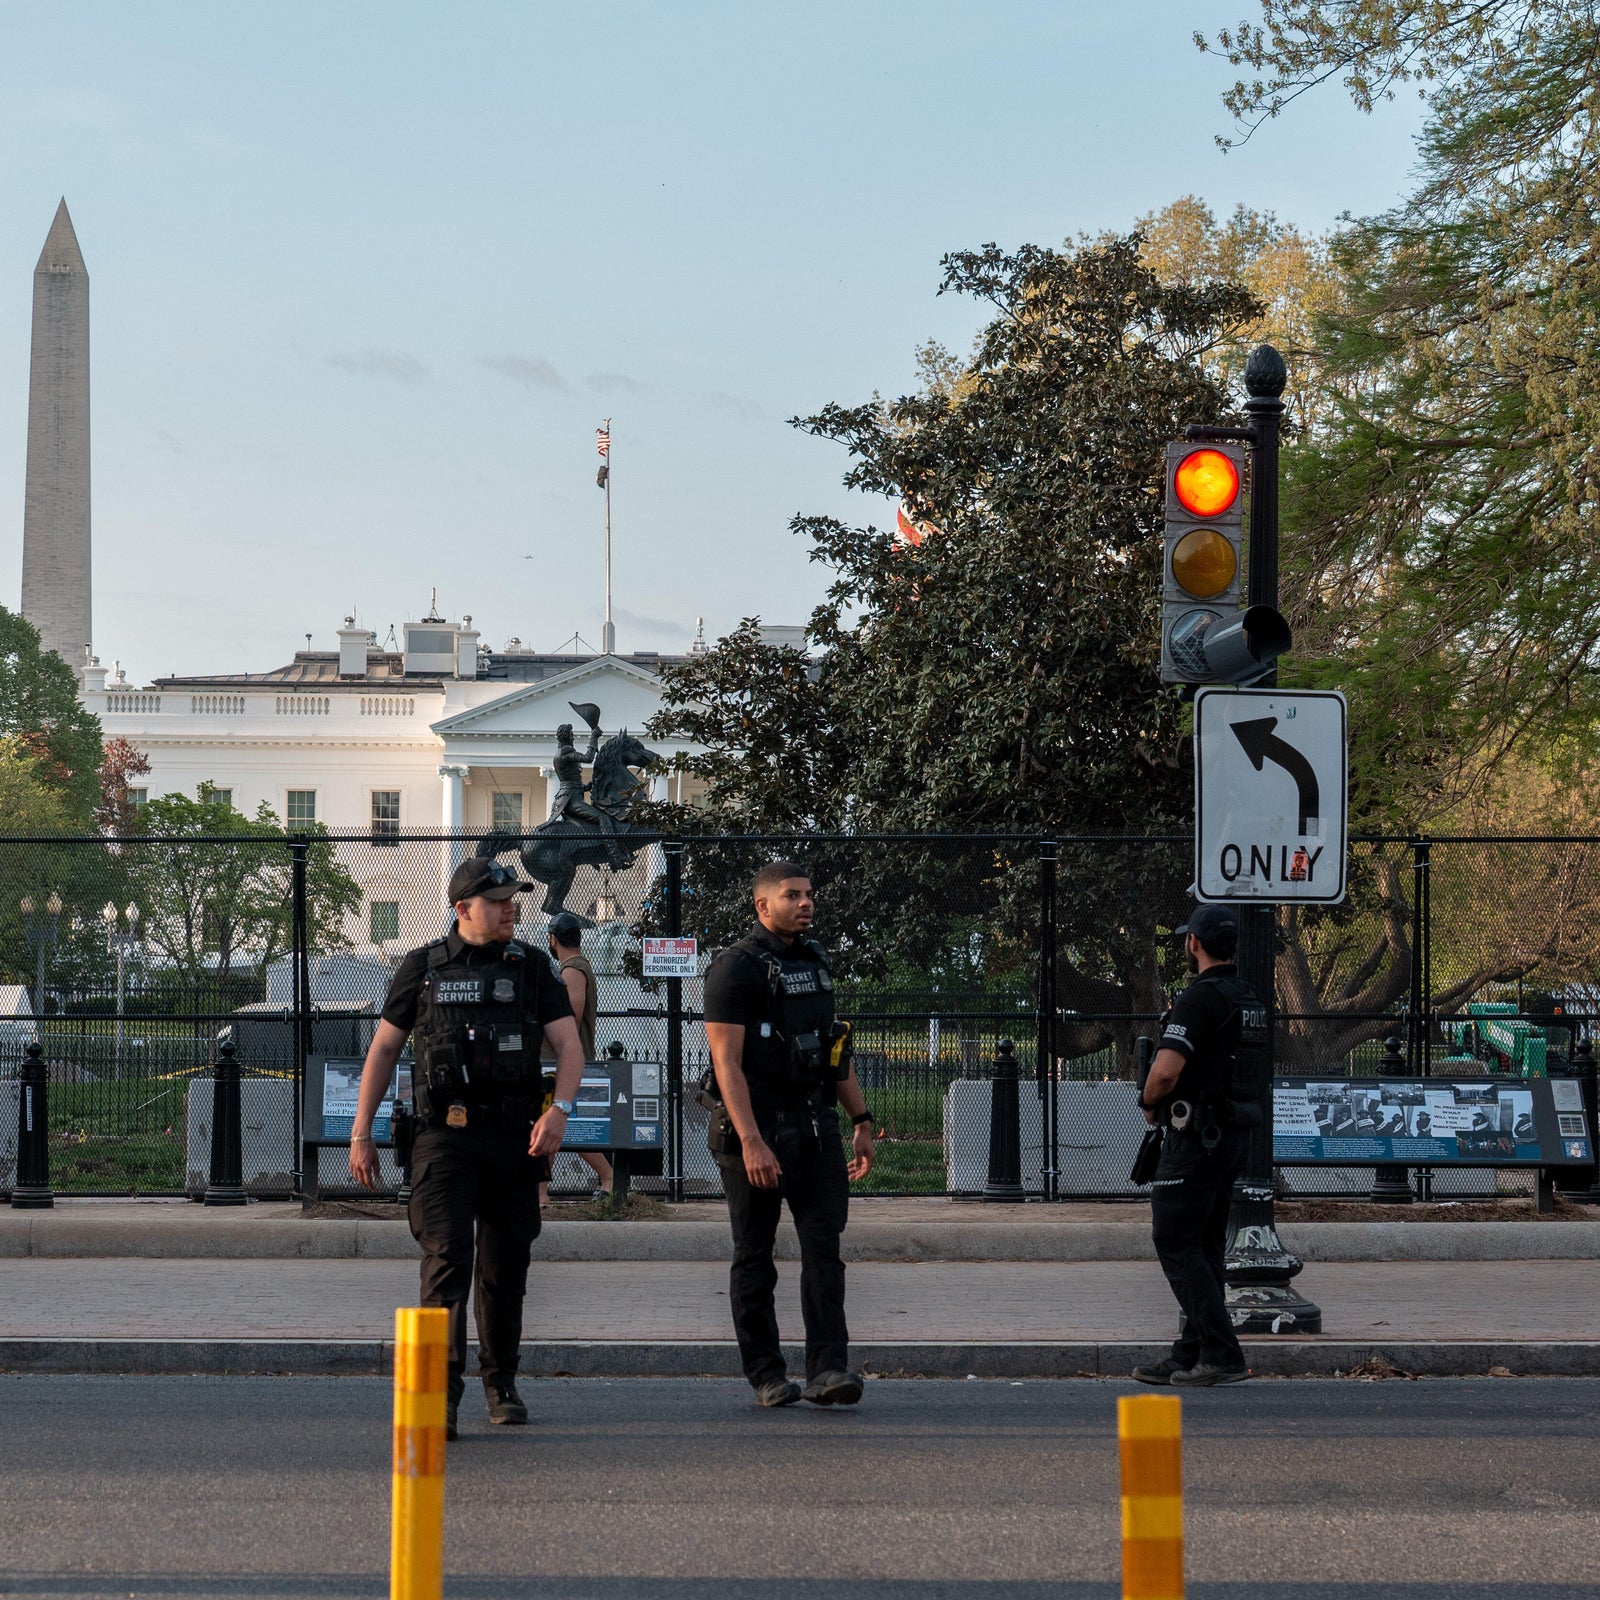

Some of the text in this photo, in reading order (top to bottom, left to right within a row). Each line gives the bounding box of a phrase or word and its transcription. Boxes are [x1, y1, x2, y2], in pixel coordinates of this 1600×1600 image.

[1221, 844, 1324, 882] ONLY
[652, 956, 688, 964] AUTHORIZED
[645, 965, 695, 973] PERSONNEL ONLY
[785, 972, 812, 983] SECRET
[440, 981, 480, 991] SECRET
[786, 982, 816, 993] SERVICE
[437, 992, 480, 1002] SERVICE
